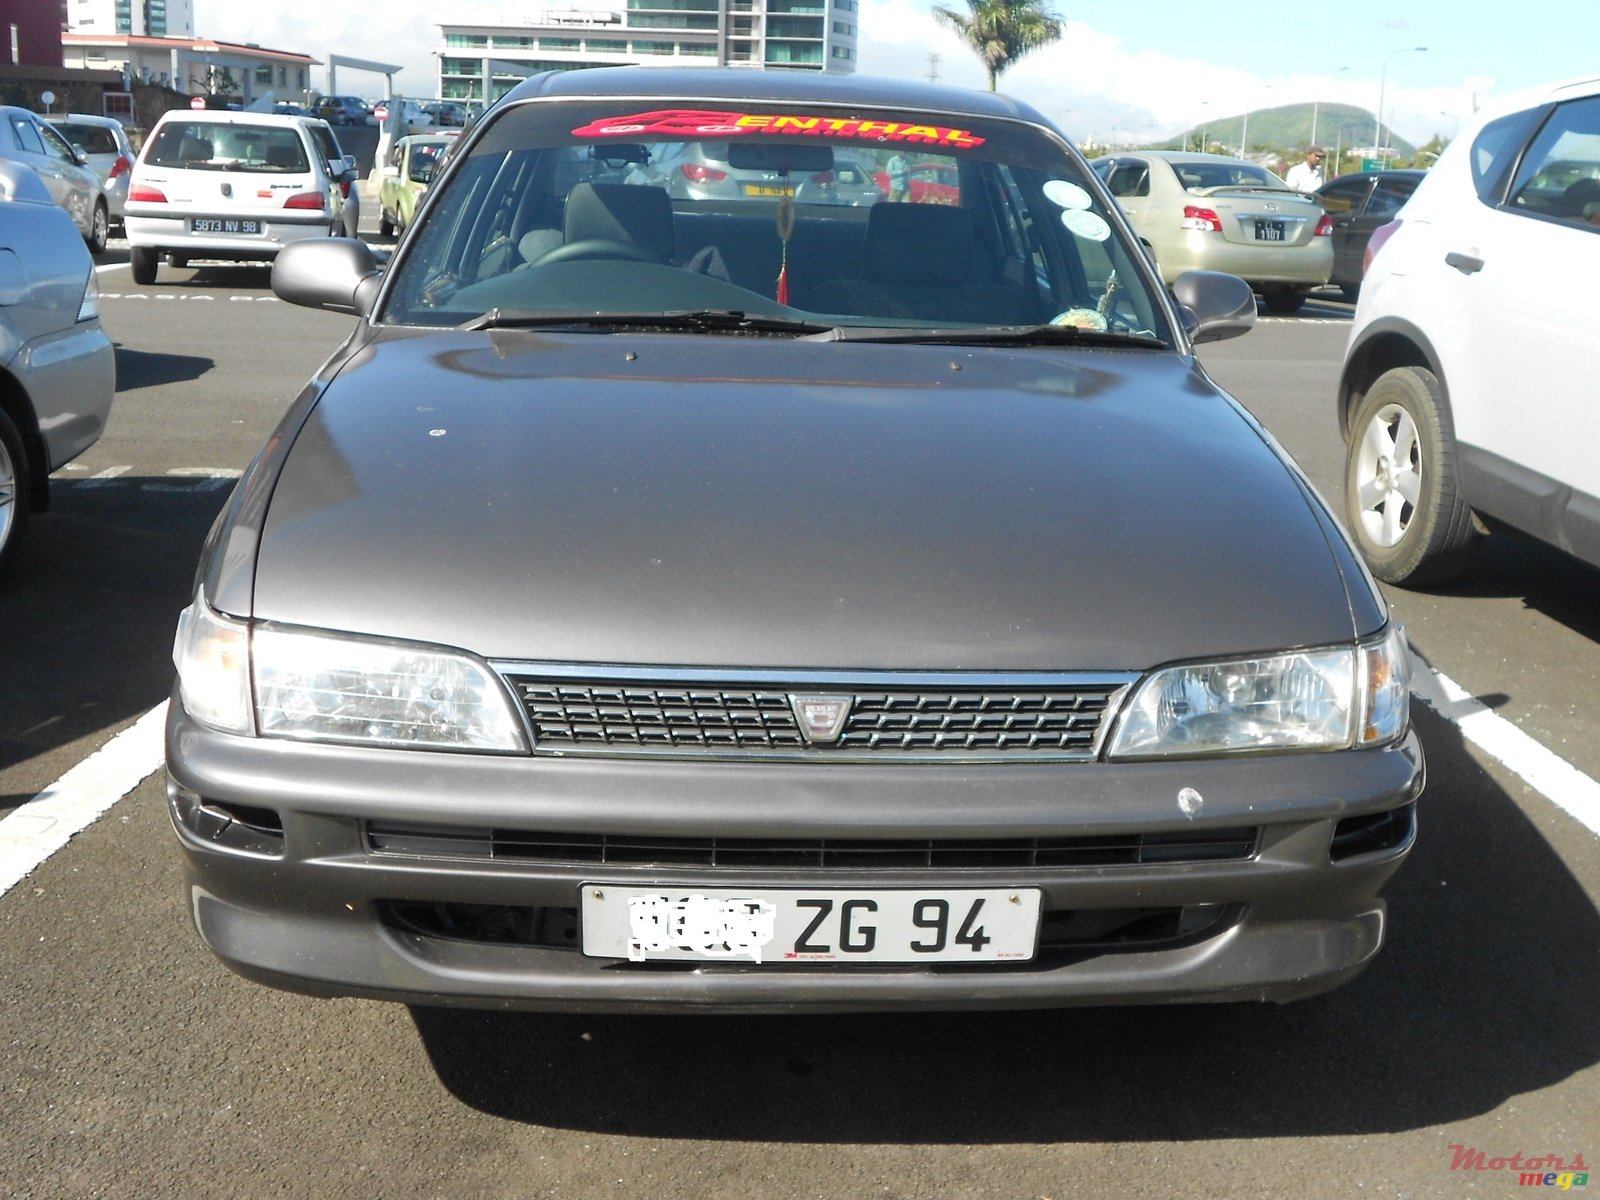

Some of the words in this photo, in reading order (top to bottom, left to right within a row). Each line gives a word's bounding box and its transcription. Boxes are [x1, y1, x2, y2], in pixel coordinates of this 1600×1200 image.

[195, 219, 222, 231] 5873
[225, 220, 239, 232] NV
[242, 221, 256, 233] 98
[1260, 229, 1280, 240] 1107
[794, 898, 878, 954] ZG
[909, 898, 991, 954] 94
